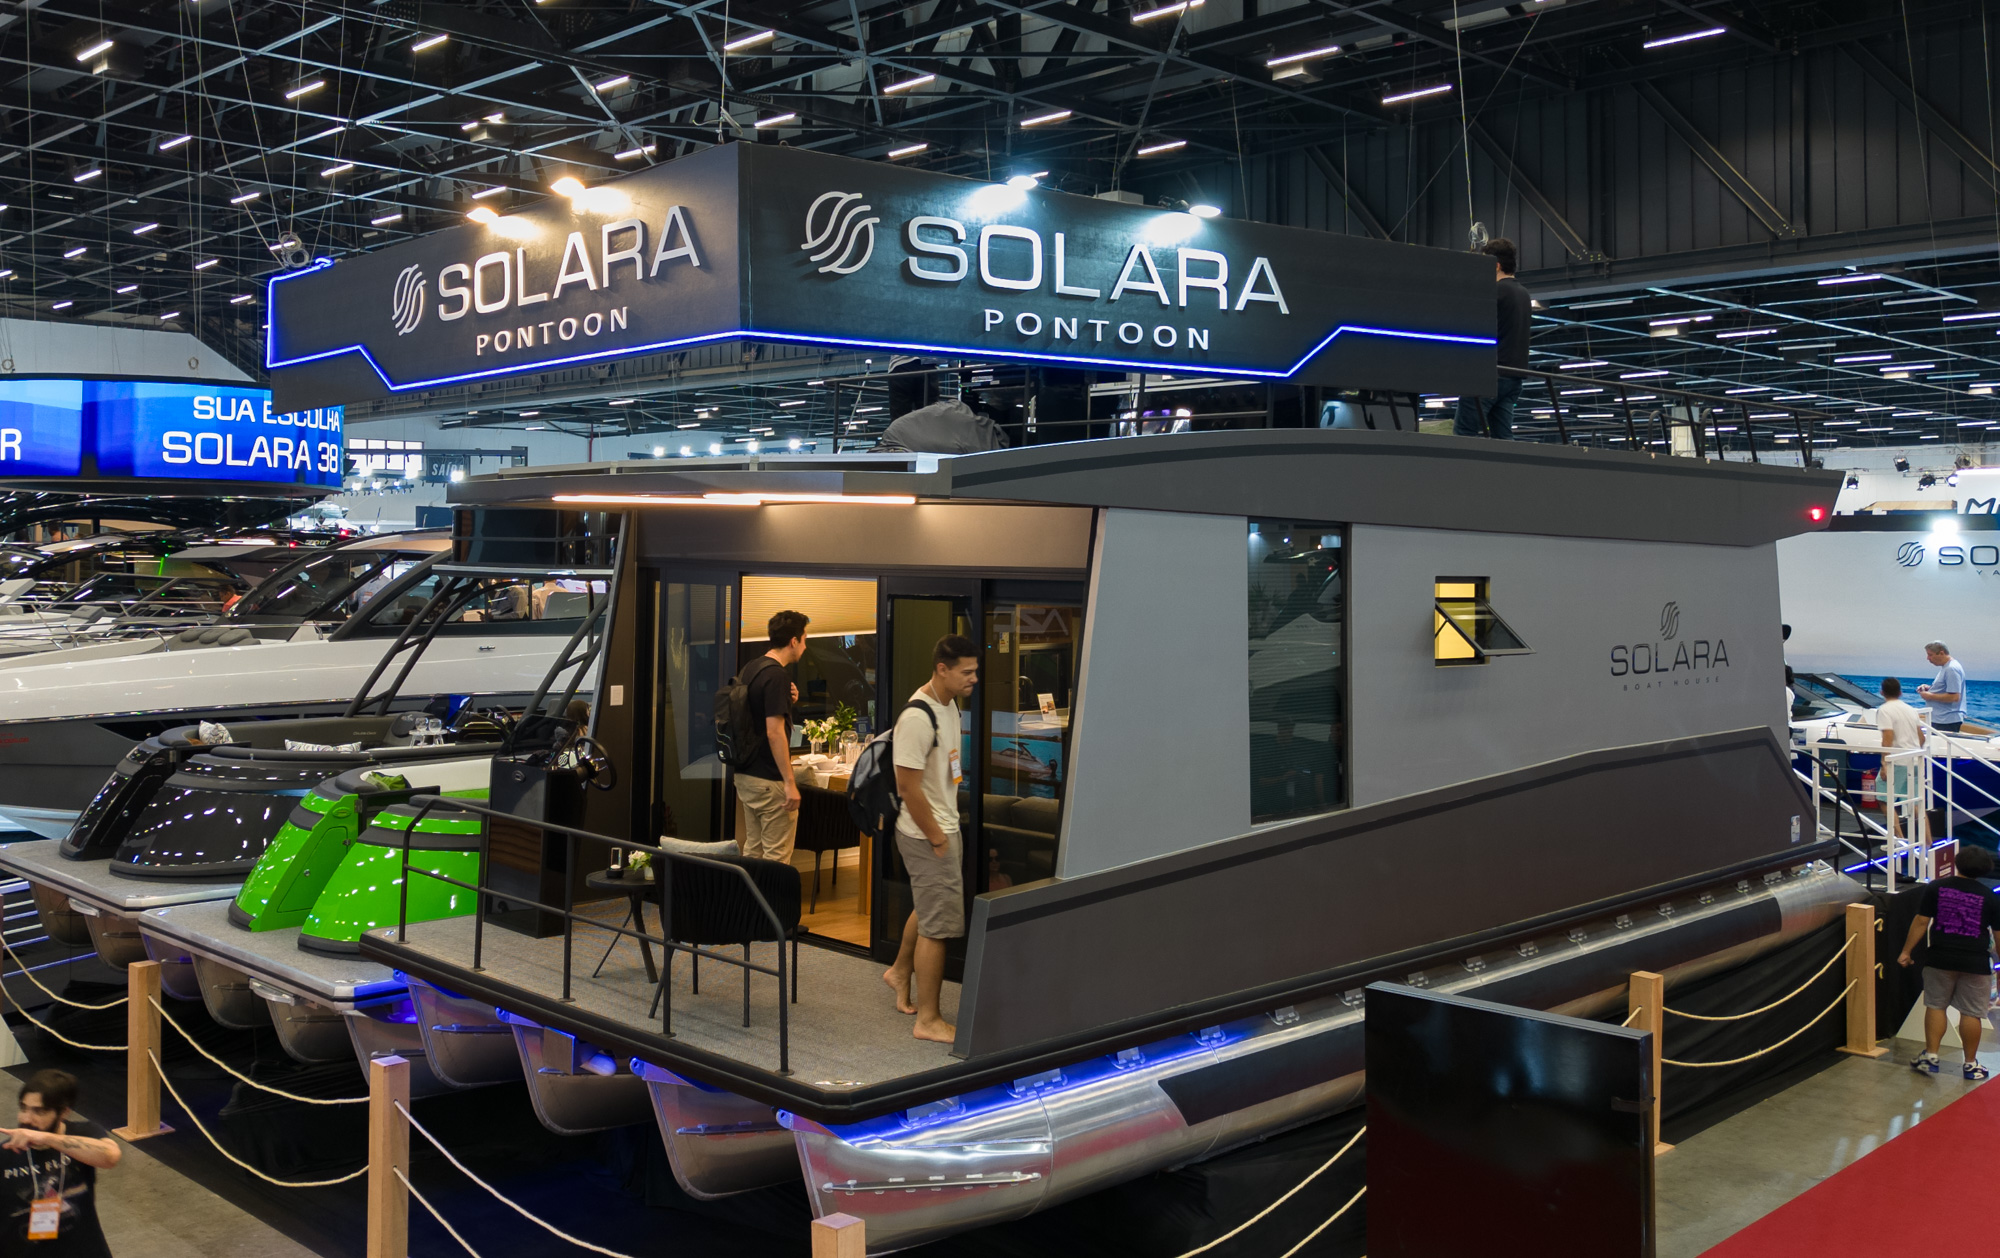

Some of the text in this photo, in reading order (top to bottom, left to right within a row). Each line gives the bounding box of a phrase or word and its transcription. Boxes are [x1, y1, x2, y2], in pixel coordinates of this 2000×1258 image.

[438, 205, 700, 322] SOLARA
[908, 215, 1290, 315] SOLARA
[476, 306, 628, 356] PONTOON
[984, 309, 1209, 351] PONTOON
[193, 396, 256, 422] SUA
[162, 431, 339, 473] SOLARA 38
[1938, 545, 1999, 566] SO
[1611, 639, 1729, 676] SOLARA
[1623, 676, 1719, 691] BOAT HOUSE
